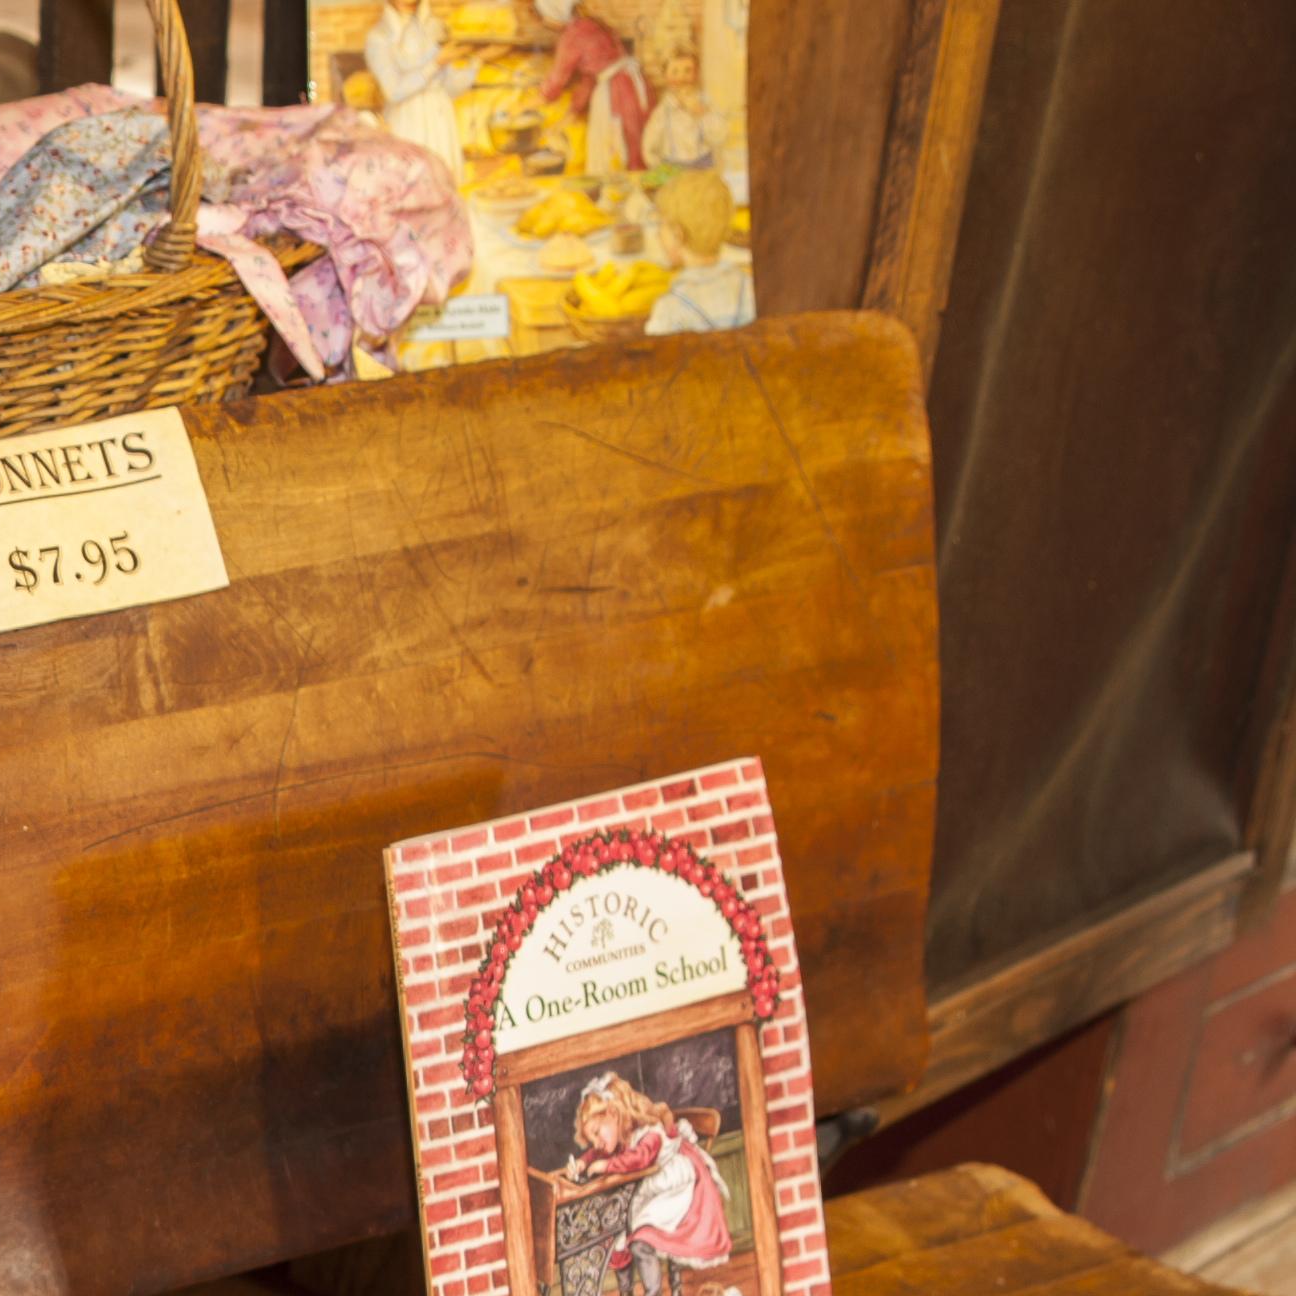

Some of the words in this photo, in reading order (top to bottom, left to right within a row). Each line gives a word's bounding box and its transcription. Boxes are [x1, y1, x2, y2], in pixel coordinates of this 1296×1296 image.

[7, 530, 140, 595] $7.95
[543, 891, 669, 963] HISTORIC
[565, 944, 646, 974] COMMUNITIES
[497, 999, 518, 1031] A
[525, 976, 648, 1026] One-Room
[654, 946, 728, 989] School
